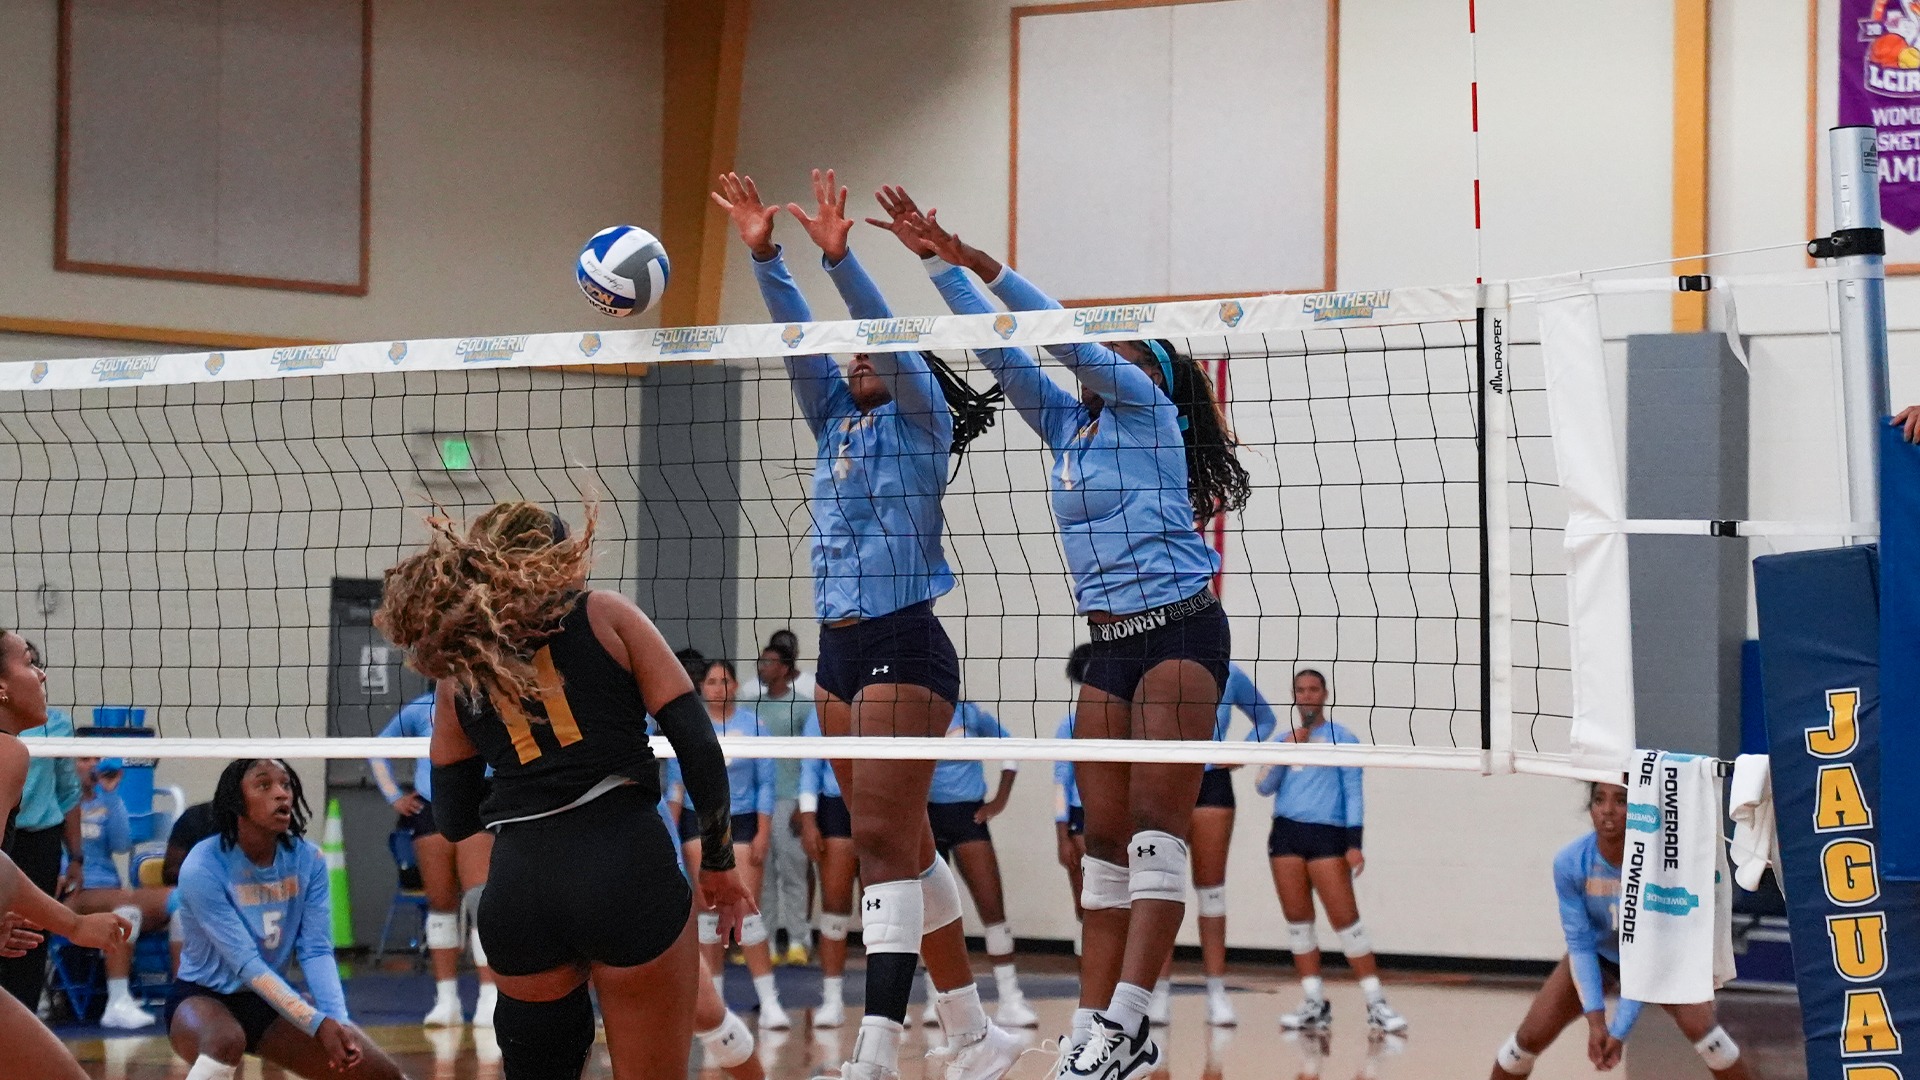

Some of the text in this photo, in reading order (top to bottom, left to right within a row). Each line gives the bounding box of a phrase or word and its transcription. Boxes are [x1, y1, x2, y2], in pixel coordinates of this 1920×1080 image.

[1302, 289, 1391, 313] SOUTHERN
[857, 316, 937, 337] SOUTHERN
[1074, 306, 1156, 327] SOUTHERN
[456, 335, 528, 355] SOUTHERN
[652, 327, 728, 347] SOUTHERN
[1494, 318, 1503, 370] DRAPER
[91, 356, 161, 374] SOUTHERN
[271, 344, 342, 364] SOUTHERN
[1167, 593, 1216, 621] NDER
[1098, 608, 1167, 642] ARMOUR
[1640, 752, 1658, 787] ADE
[1664, 767, 1679, 870] POWERADE
[1622, 841, 1645, 944] POWERADE
[1805, 687, 1903, 1080] JAGUA
[263, 911, 282, 950] 5
